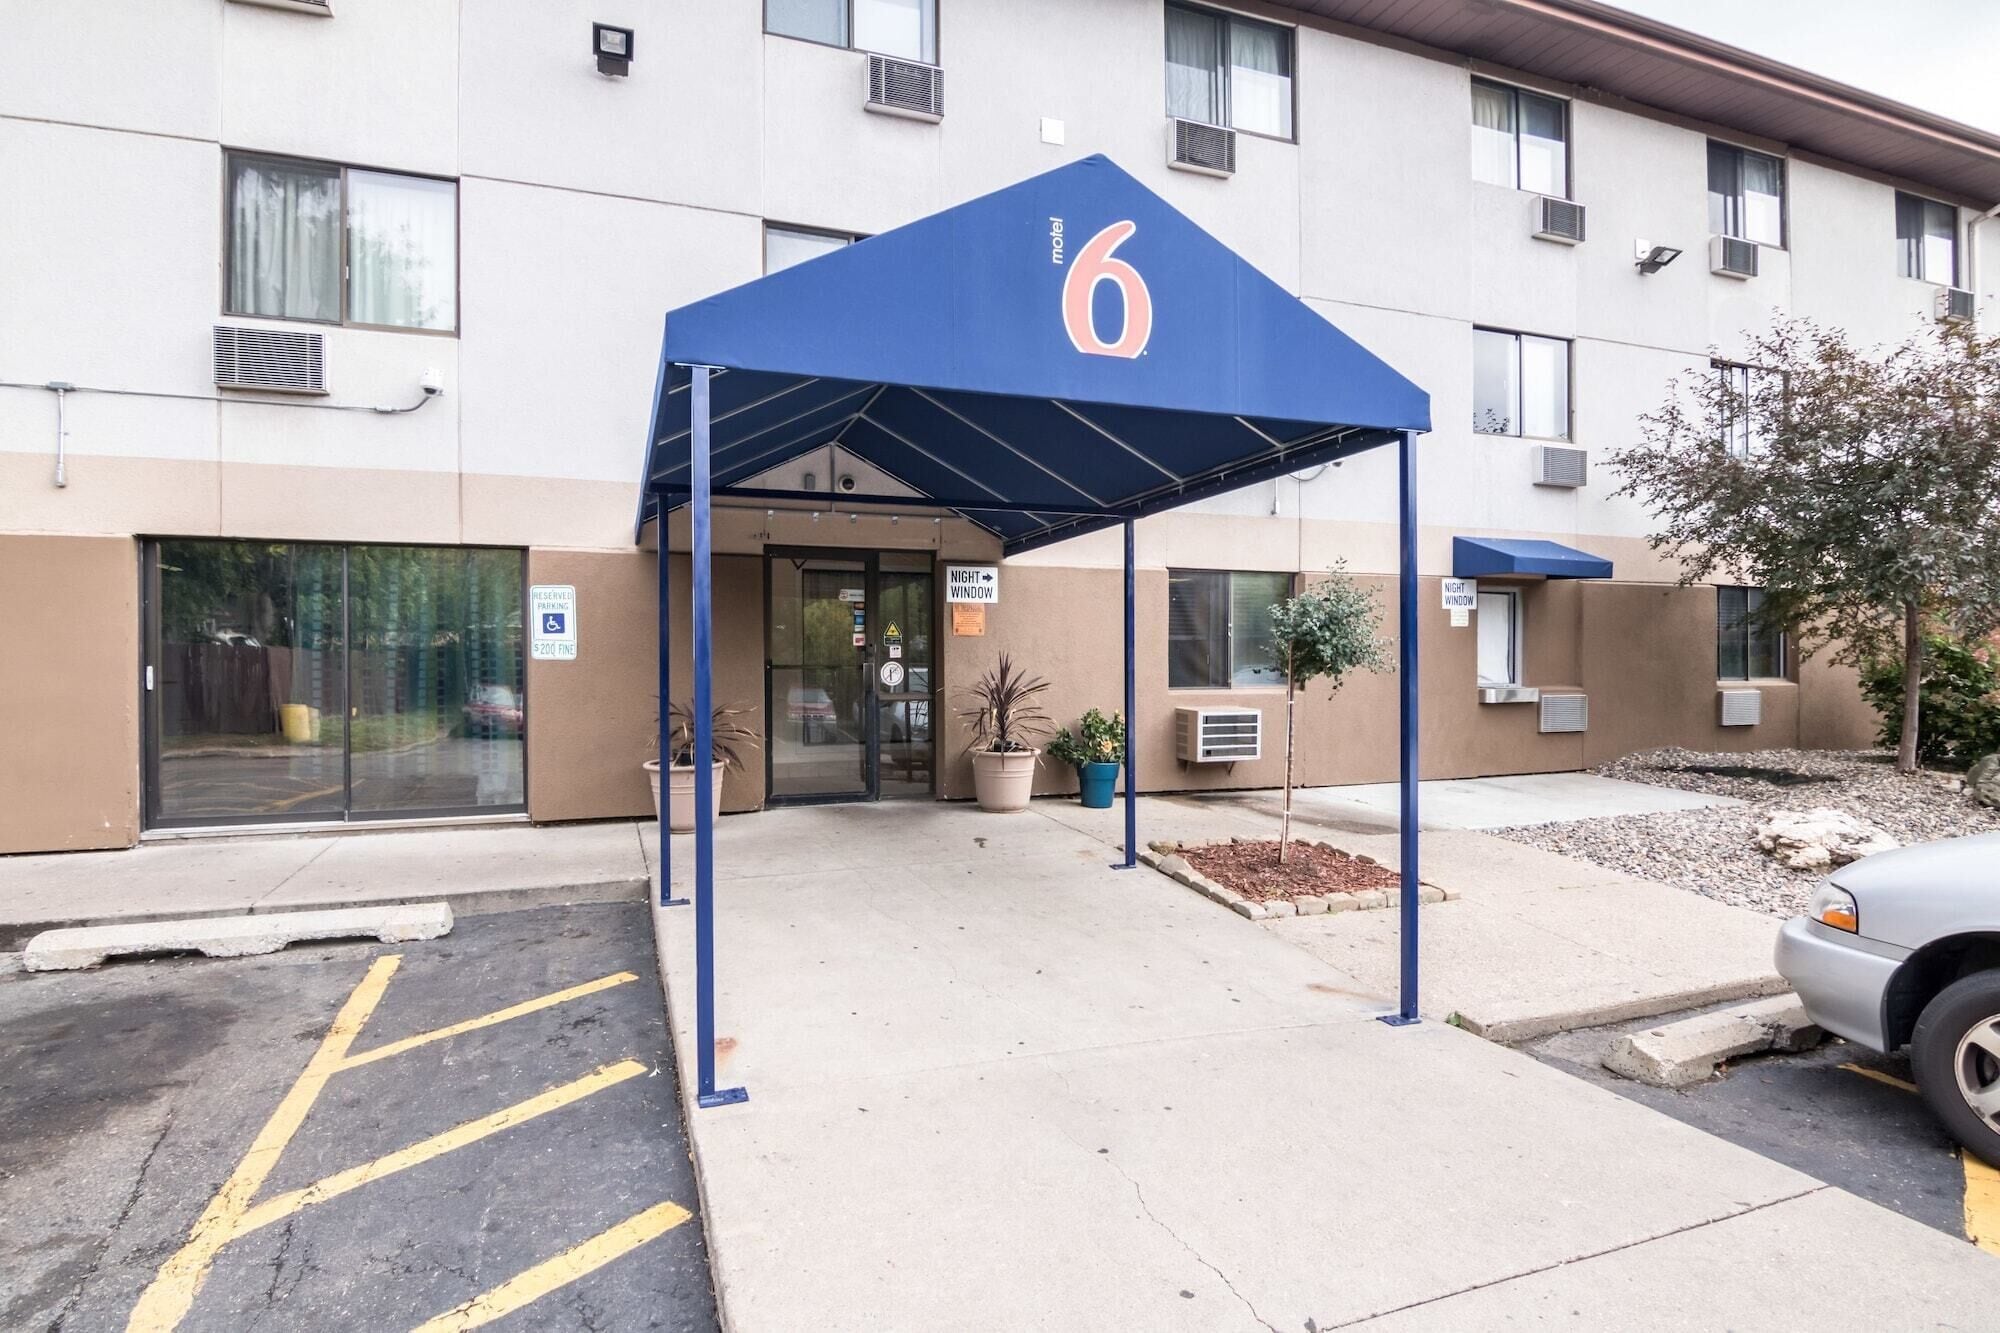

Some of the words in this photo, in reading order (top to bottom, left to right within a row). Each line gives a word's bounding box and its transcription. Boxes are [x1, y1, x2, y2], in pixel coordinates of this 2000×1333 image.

[1049, 216, 1063, 265] motel
[1062, 220, 1153, 359] 6
[951, 570, 981, 584] NIGHT
[951, 586, 993, 599] WINDOW
[1444, 582, 1465, 593] NIGHT
[533, 591, 573, 601] RESERVED
[1444, 595, 1474, 606] WINDOW
[537, 602, 569, 610] PARKING
[558, 643, 575, 656] FINE
